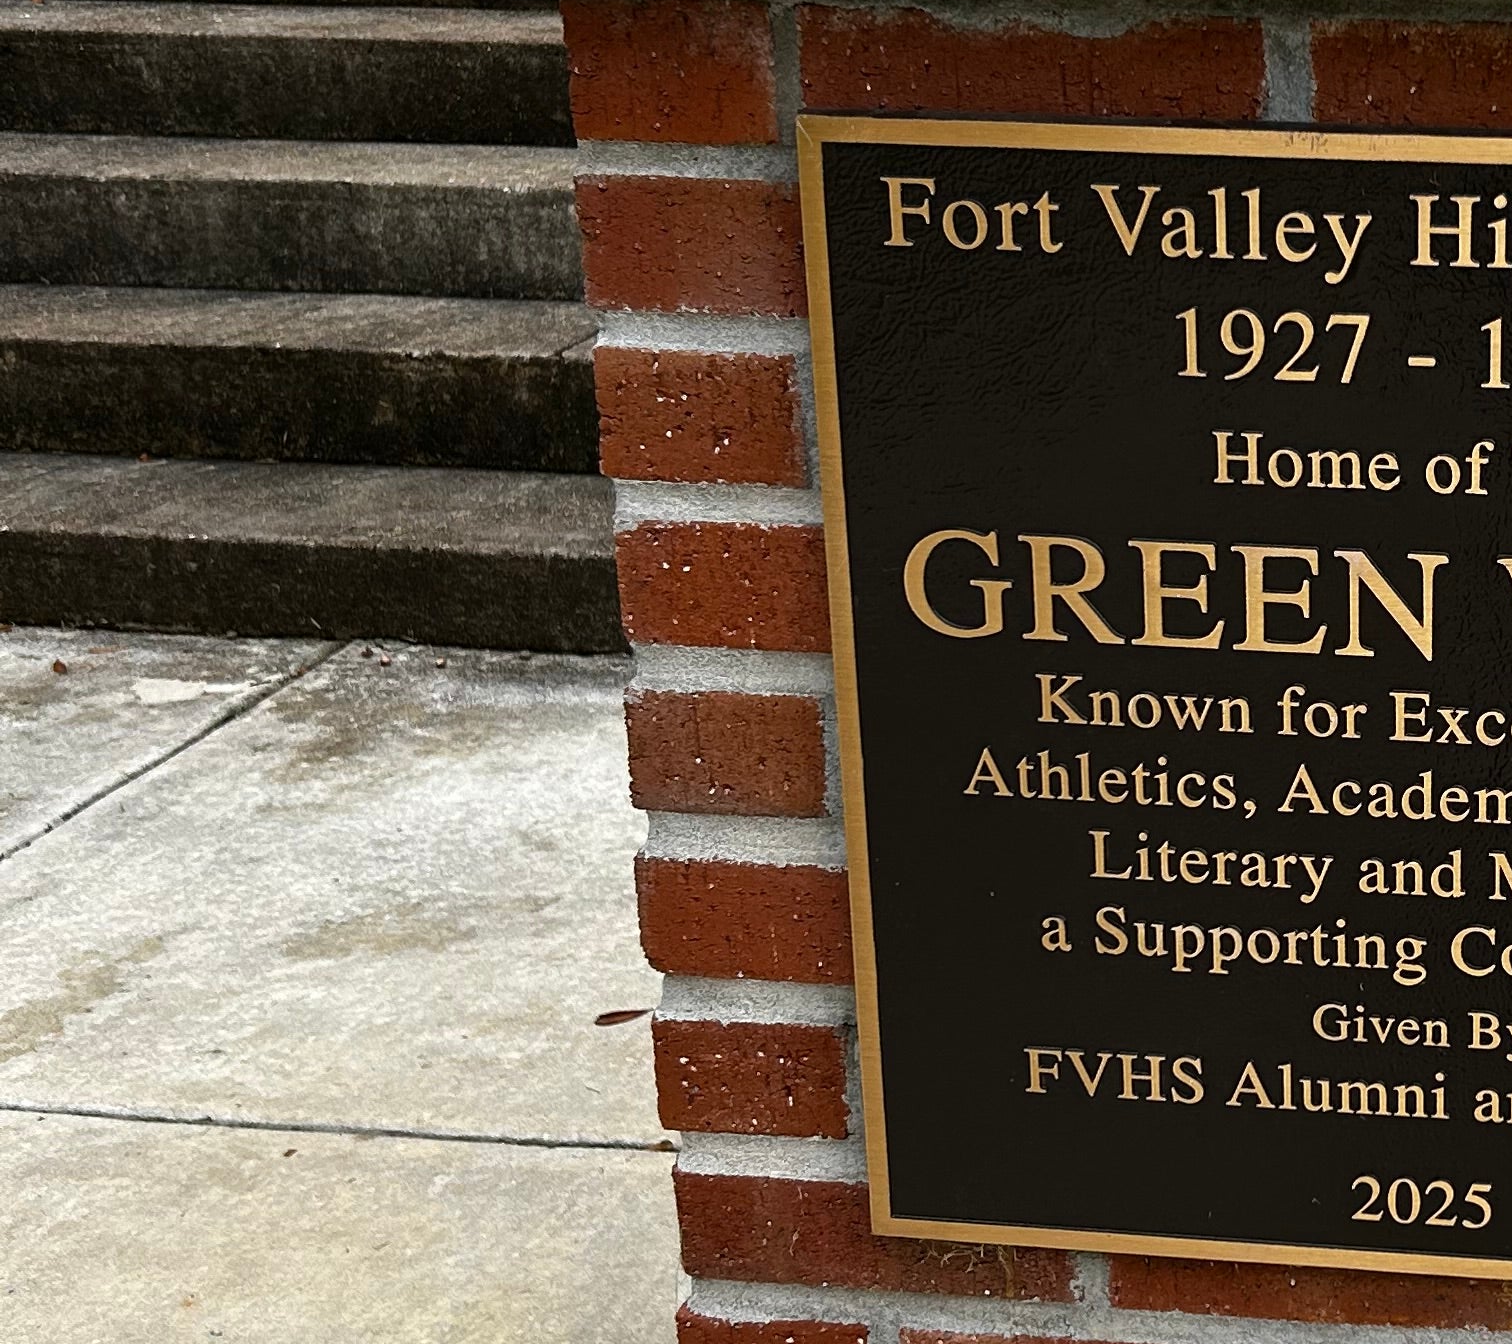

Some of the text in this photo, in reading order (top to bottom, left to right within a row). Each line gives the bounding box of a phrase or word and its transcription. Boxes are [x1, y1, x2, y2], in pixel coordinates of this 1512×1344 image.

[880, 177, 1063, 253] Fort
[1090, 184, 1372, 284] Valley
[1176, 308, 1370, 383] 1927
[1408, 356, 1436, 367] -
[1212, 431, 1400, 490] Home
[1426, 441, 1494, 495] of
[904, 530, 1449, 661] GREEN
[1035, 674, 1254, 733] Known
[1277, 686, 1367, 738] for
[964, 748, 1256, 819] Athletics,
[1089, 831, 1333, 903] Literary
[1359, 848, 1466, 898] and
[1042, 917, 1072, 951] a
[1095, 907, 1427, 986] Supporting
[1313, 1004, 1450, 1047] Given
[1024, 1049, 1204, 1104] FVHS
[1226, 1062, 1449, 1119] Alumni
[1352, 1176, 1491, 1228] 2025
